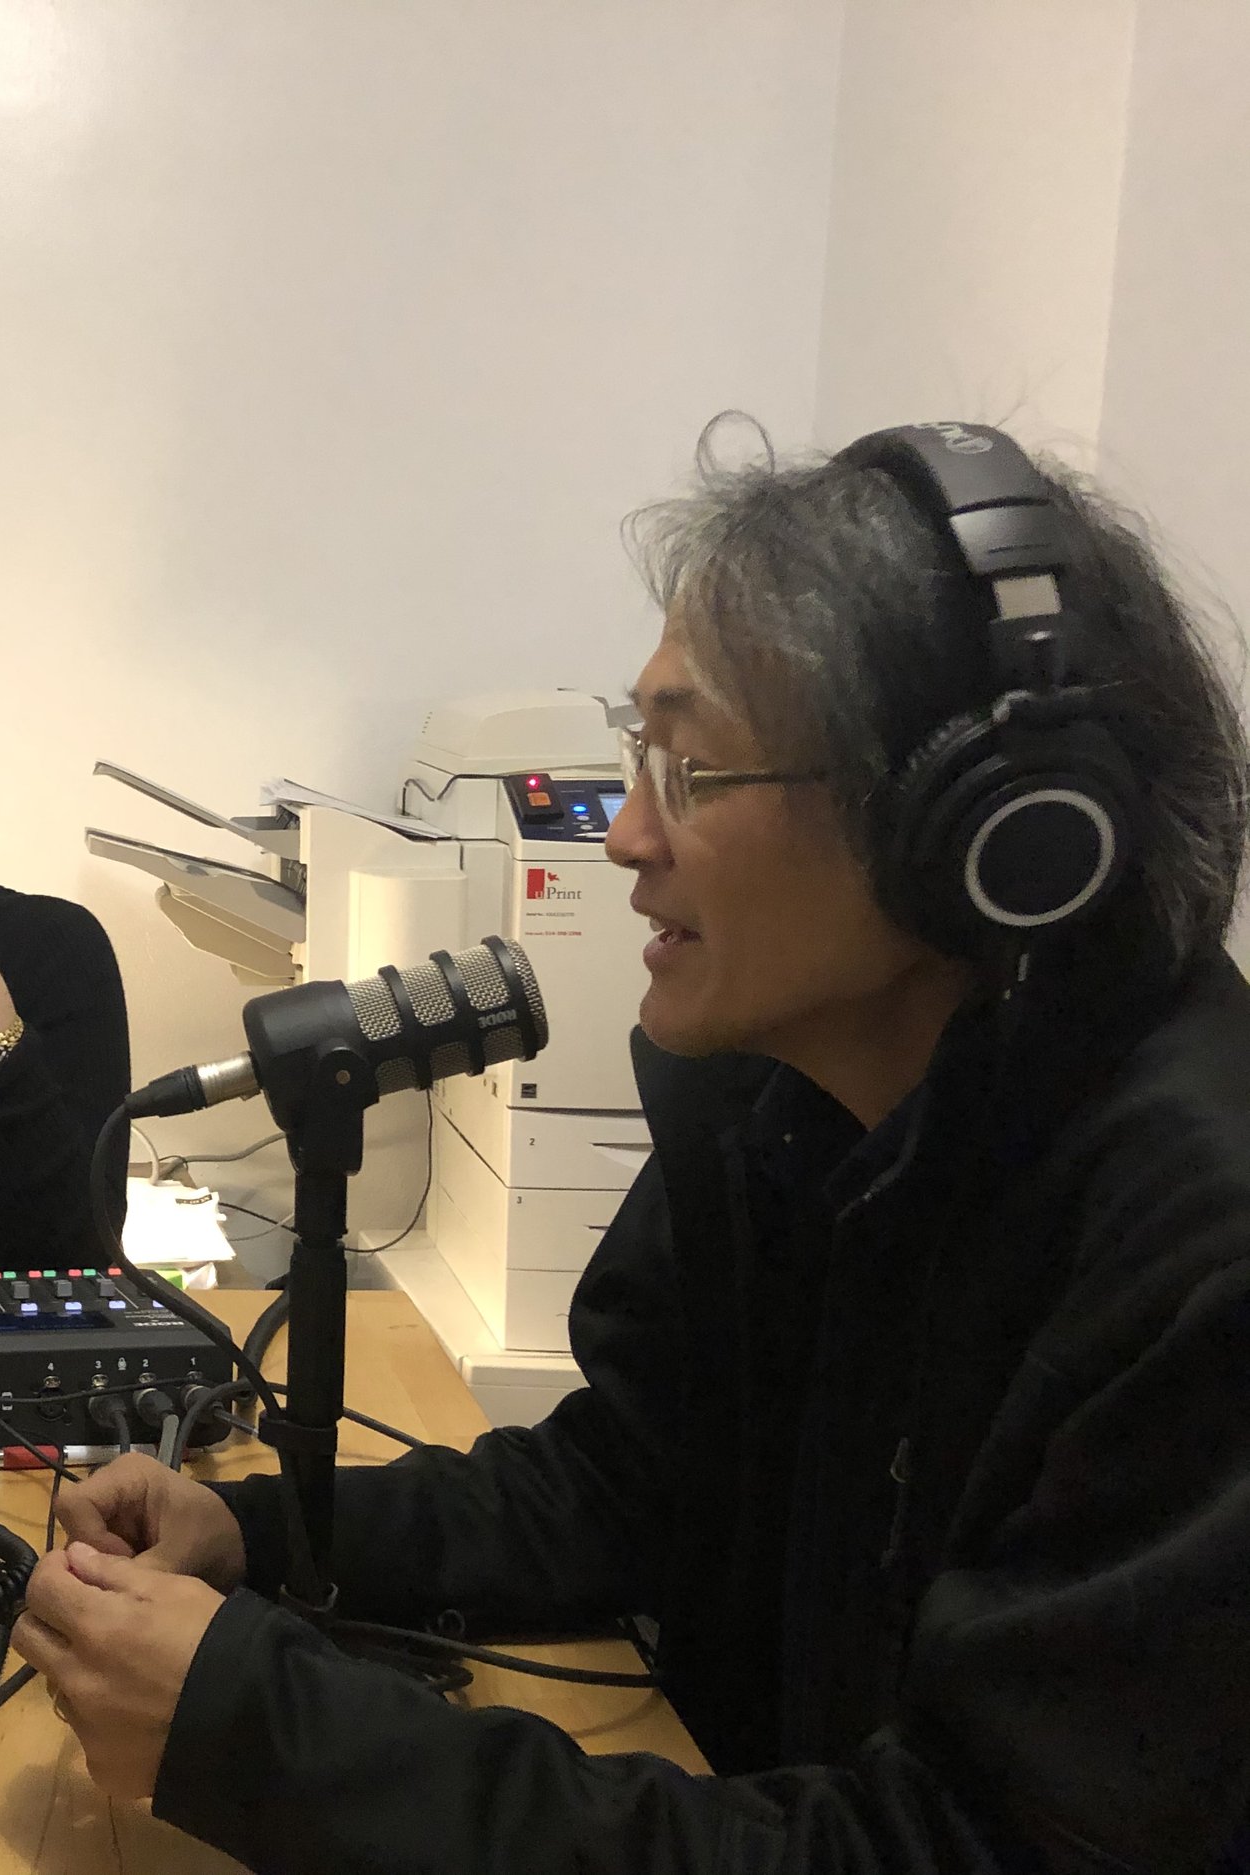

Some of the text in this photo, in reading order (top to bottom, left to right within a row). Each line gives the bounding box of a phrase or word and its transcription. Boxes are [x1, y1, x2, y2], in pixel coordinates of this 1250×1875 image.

[529, 1138, 535, 1146] 2
[516, 1196, 522, 1204] 3
[95, 1360, 102, 1369] 3
[142, 1358, 149, 1367] 2
[190, 1357, 196, 1366] 1
[47, 1362, 54, 1371] 4
